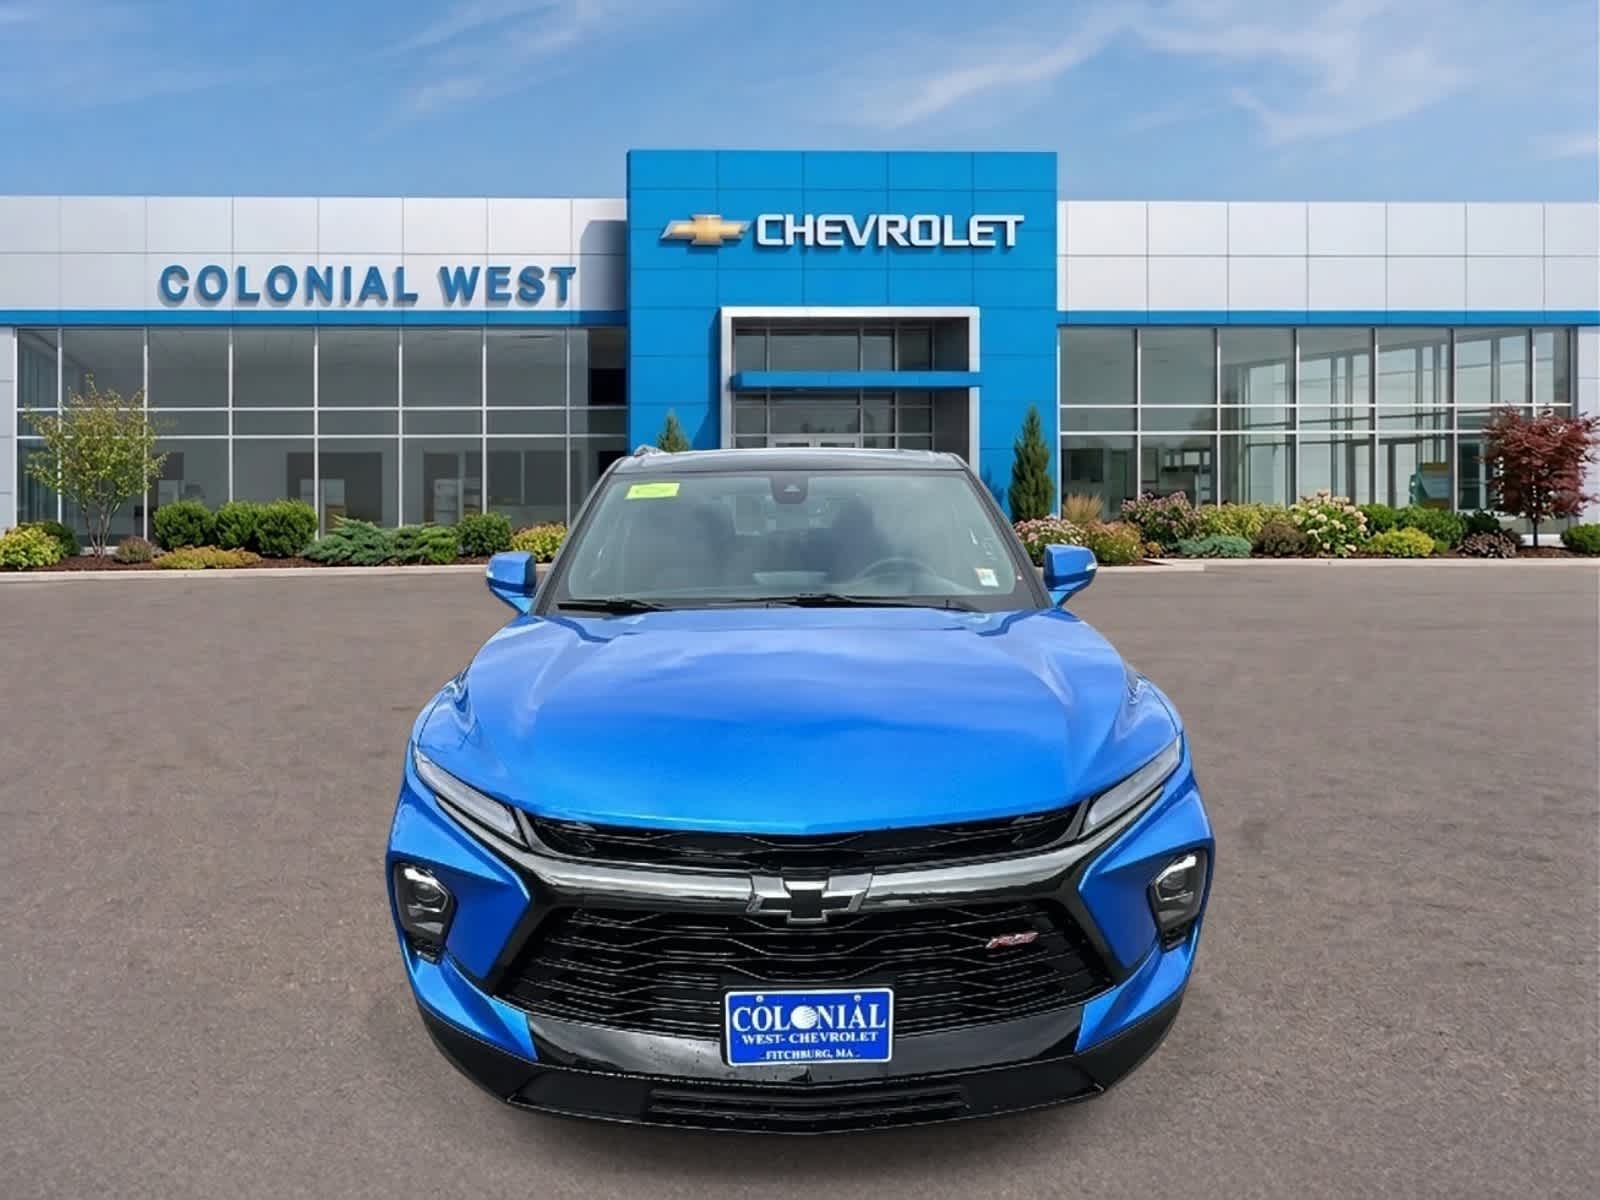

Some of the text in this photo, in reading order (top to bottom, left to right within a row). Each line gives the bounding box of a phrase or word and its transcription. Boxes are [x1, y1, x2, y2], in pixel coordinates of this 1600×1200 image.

[756, 214, 1024, 248] CHEVROLET
[158, 264, 577, 306] COLONIAL WEST
[732, 1003, 886, 1032] COLONIAL
[789, 1031, 878, 1044] CHEVROLET
